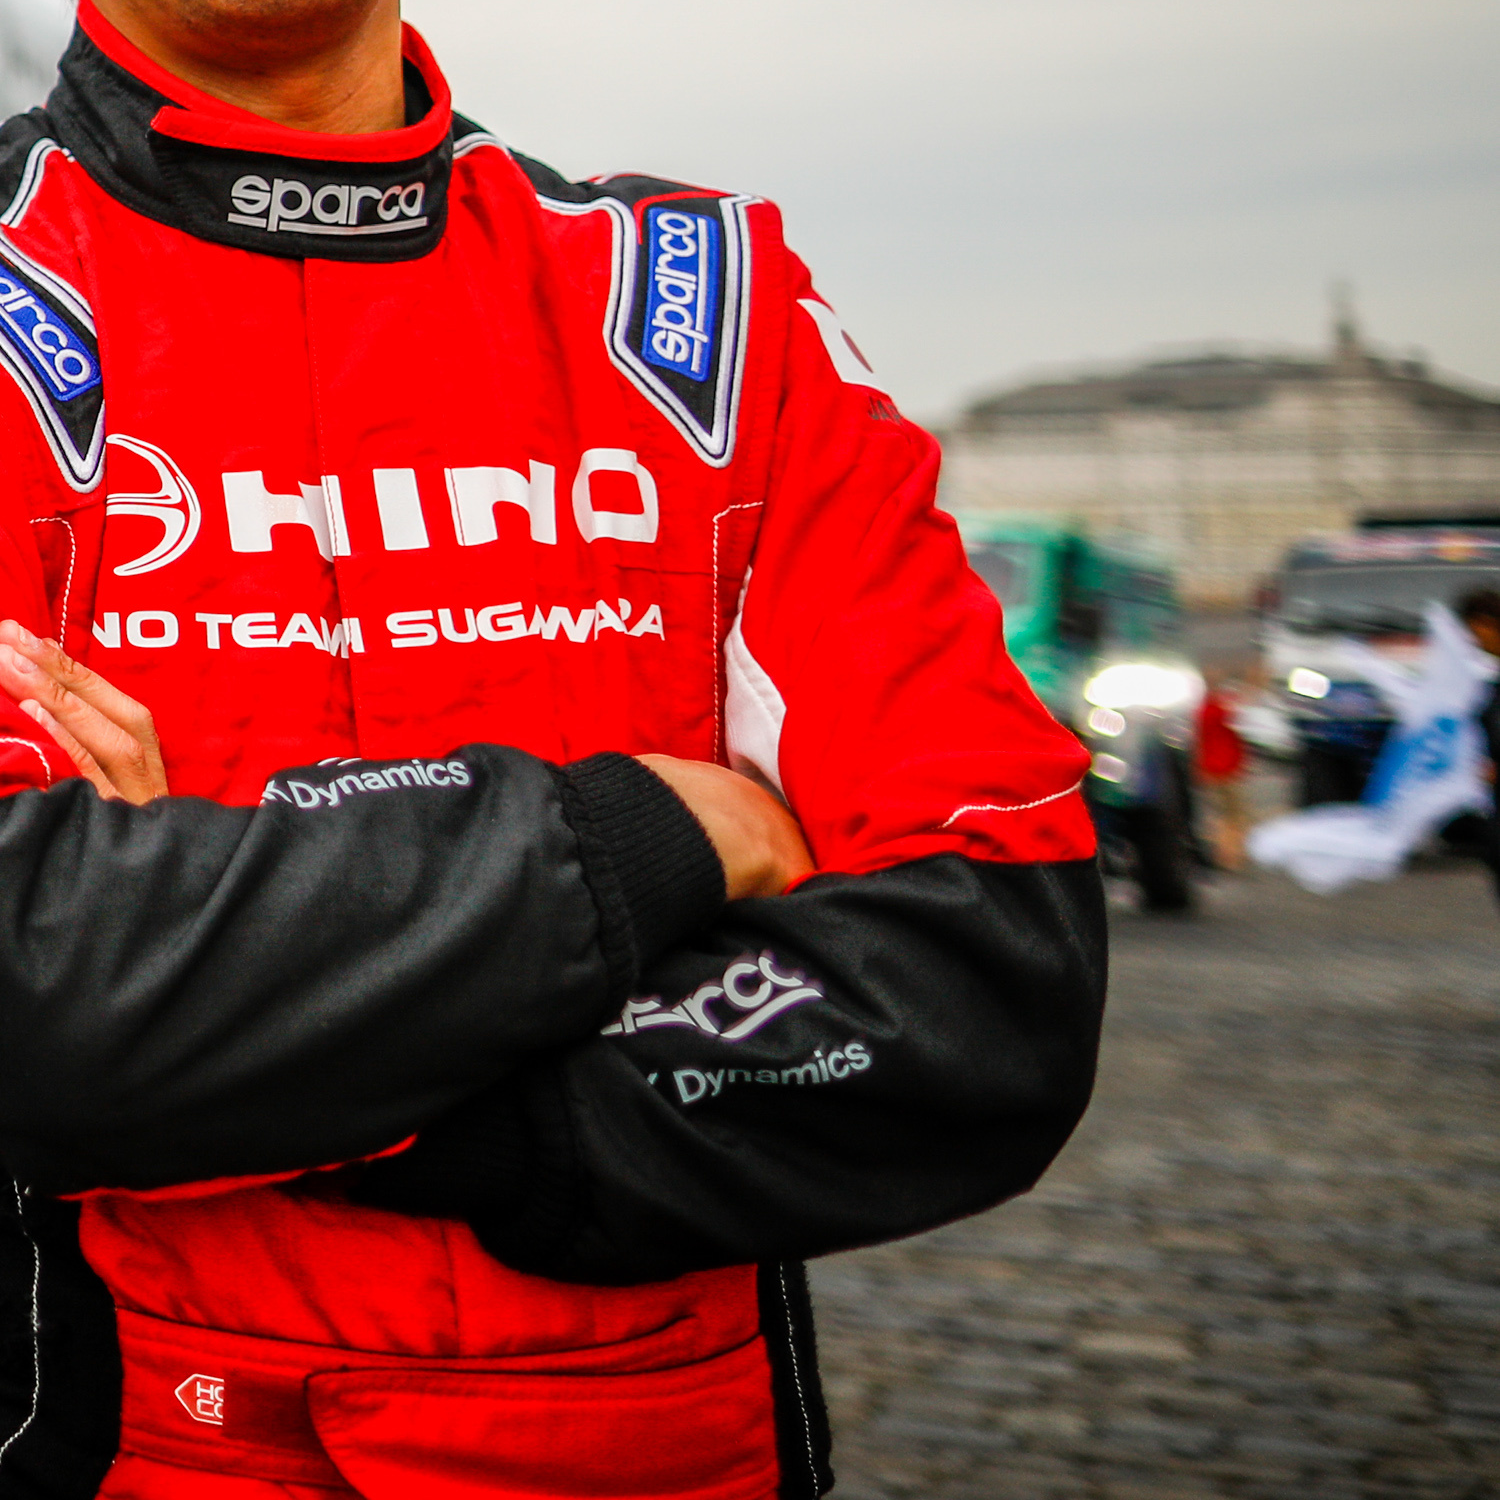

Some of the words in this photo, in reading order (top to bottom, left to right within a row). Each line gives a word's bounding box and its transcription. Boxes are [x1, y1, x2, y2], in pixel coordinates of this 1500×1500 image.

[229, 171, 428, 235] sparco
[649, 209, 711, 373] sparco
[221, 447, 659, 563] HINO
[194, 611, 366, 659] TEAM
[286, 758, 472, 810] Dynamics
[672, 1042, 873, 1104] Dynamics
